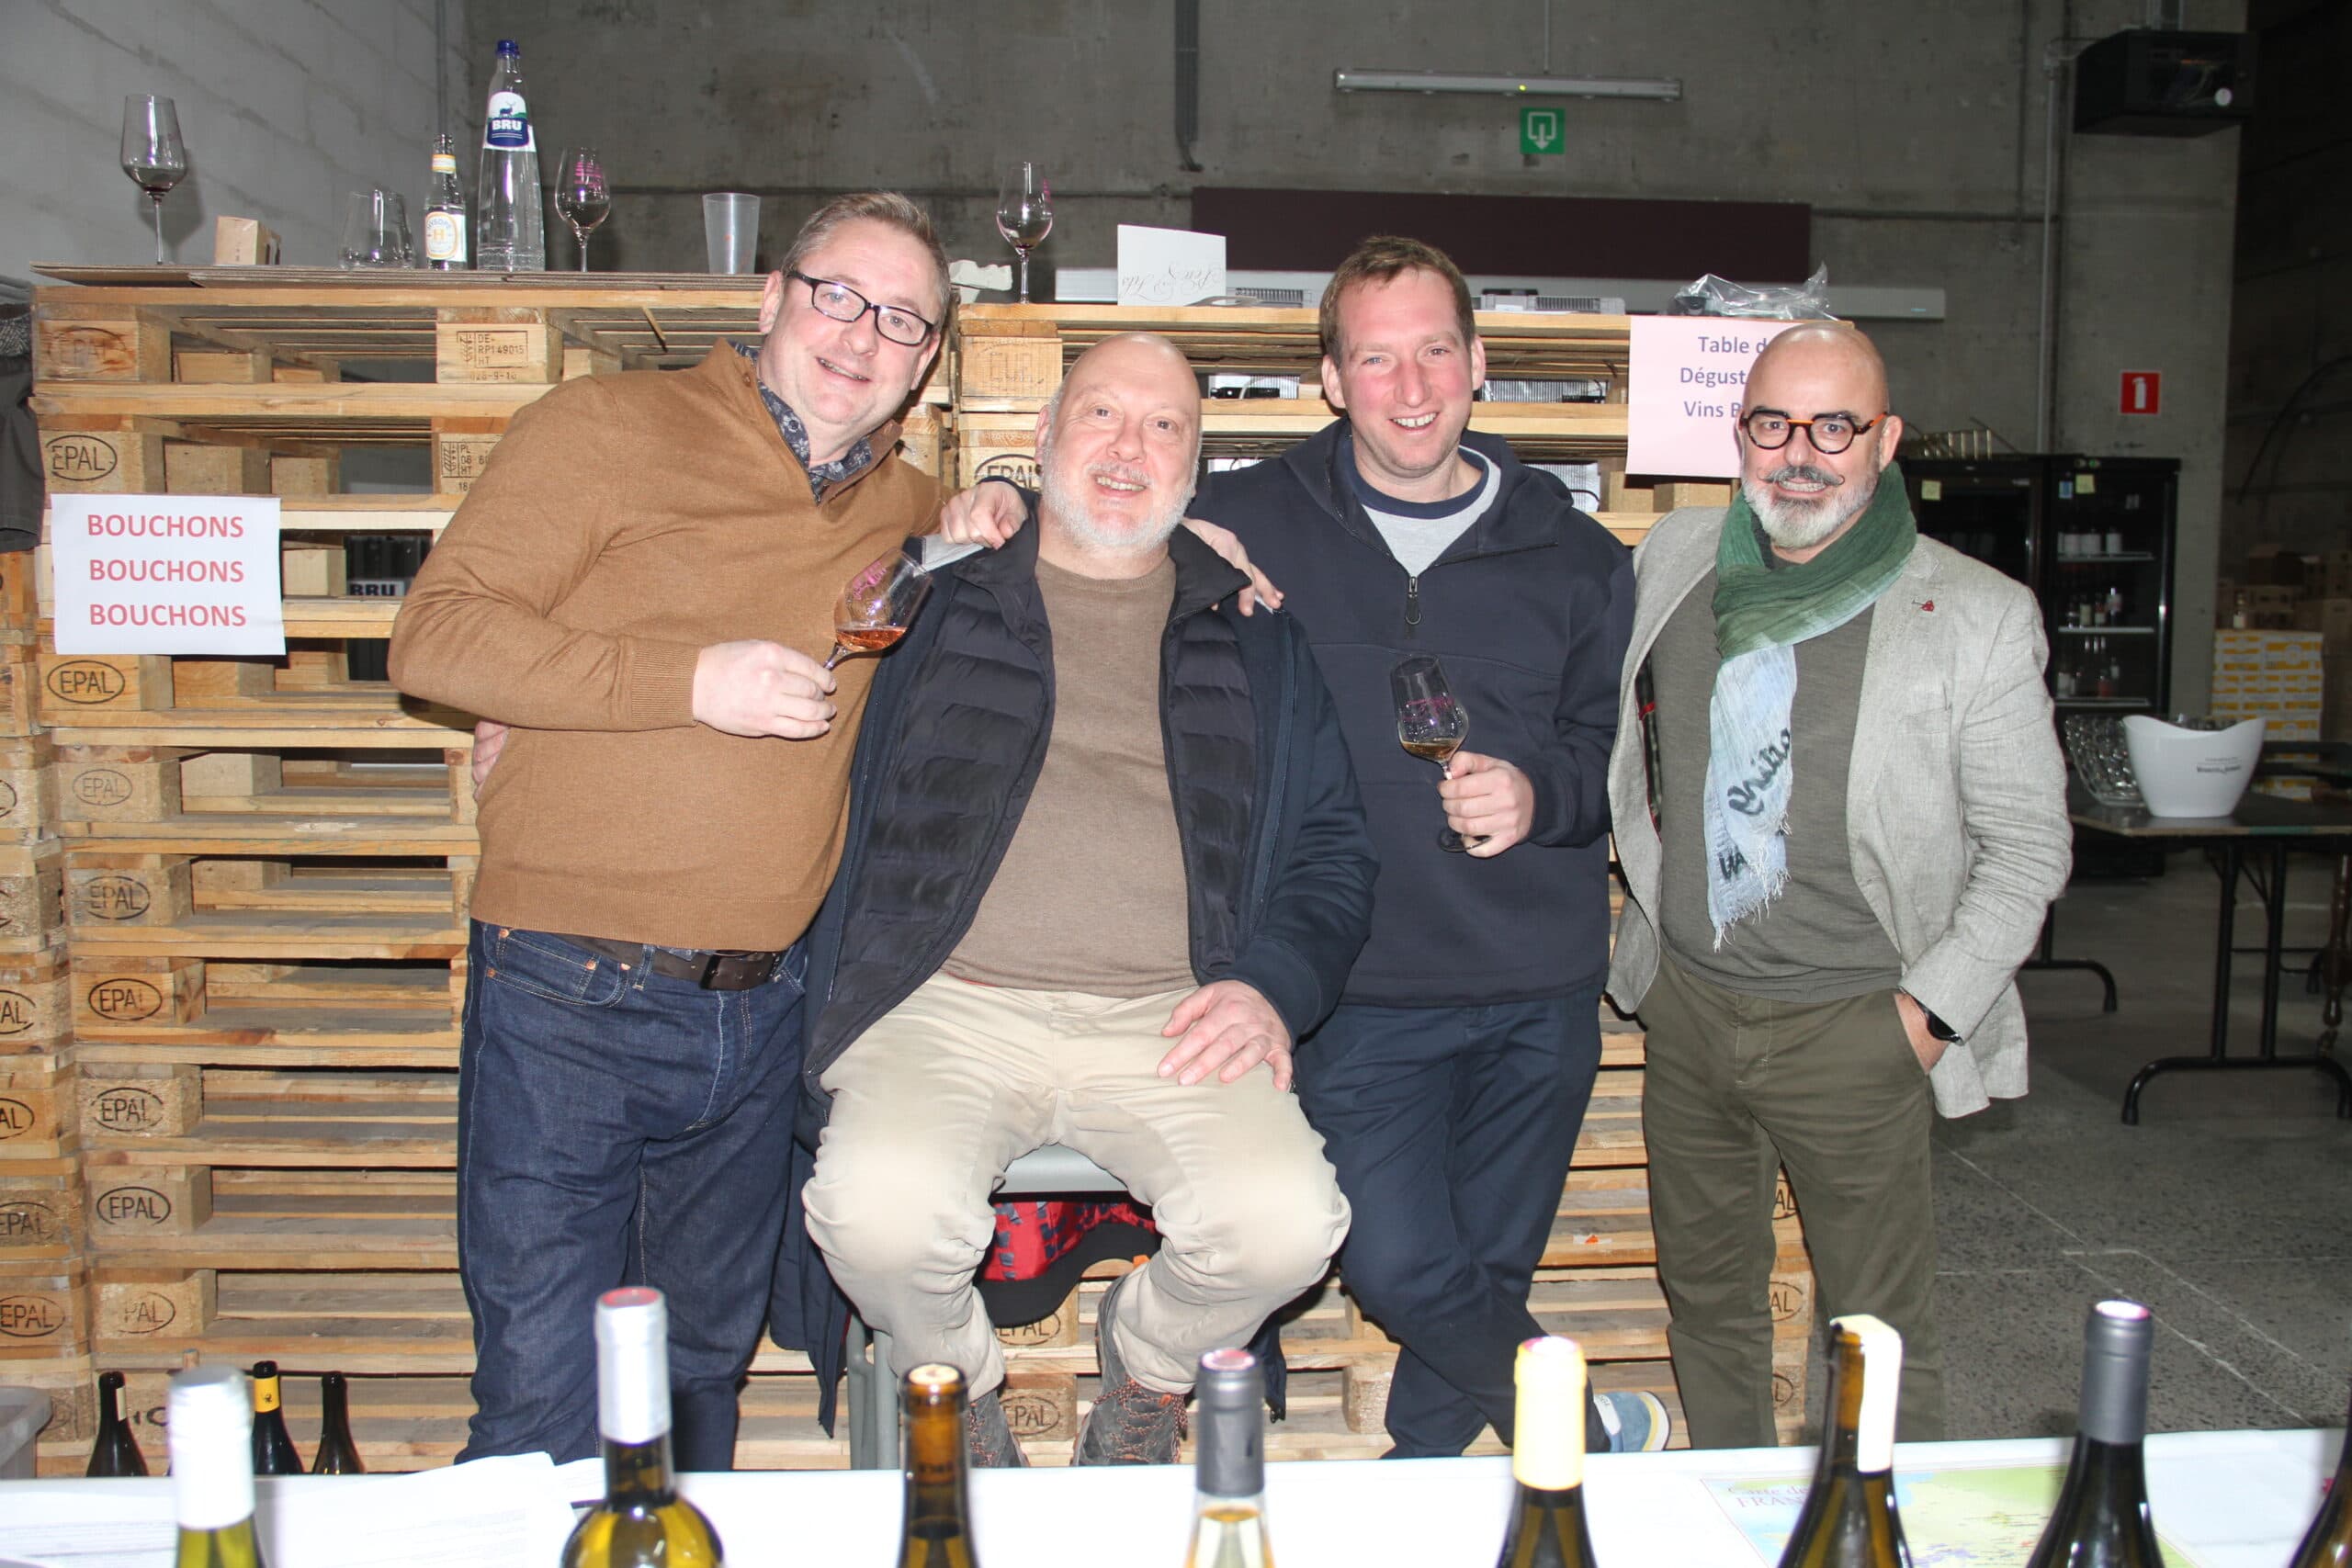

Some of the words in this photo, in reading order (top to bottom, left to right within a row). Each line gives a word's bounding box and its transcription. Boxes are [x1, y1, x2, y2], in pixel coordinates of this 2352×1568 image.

[492, 119, 523, 131] BRU
[1698, 336, 1749, 354] Table
[1756, 337, 1768, 354] d
[1680, 367, 1747, 388] Dégust
[1684, 400, 1724, 417] Vins
[51, 446, 106, 471] EPAL
[88, 514, 243, 537] BOUCHONS
[90, 559, 243, 582] BOUCHONS
[350, 583, 396, 596] BRU
[90, 604, 246, 626] BOUCHONS
[60, 671, 115, 694] EPAL
[82, 777, 125, 799] EPAL
[90, 885, 141, 910] EPAL
[0, 1000, 28, 1024] AL
[0, 1108, 23, 1130] AL
[101, 1098, 151, 1123] EPAL
[109, 1196, 161, 1220] EPAL
[1775, 1189, 1796, 1211] AL
[125, 1300, 164, 1324] PAL
[1770, 1291, 1794, 1314] AL
[0, 1304, 53, 1329] EPAL
